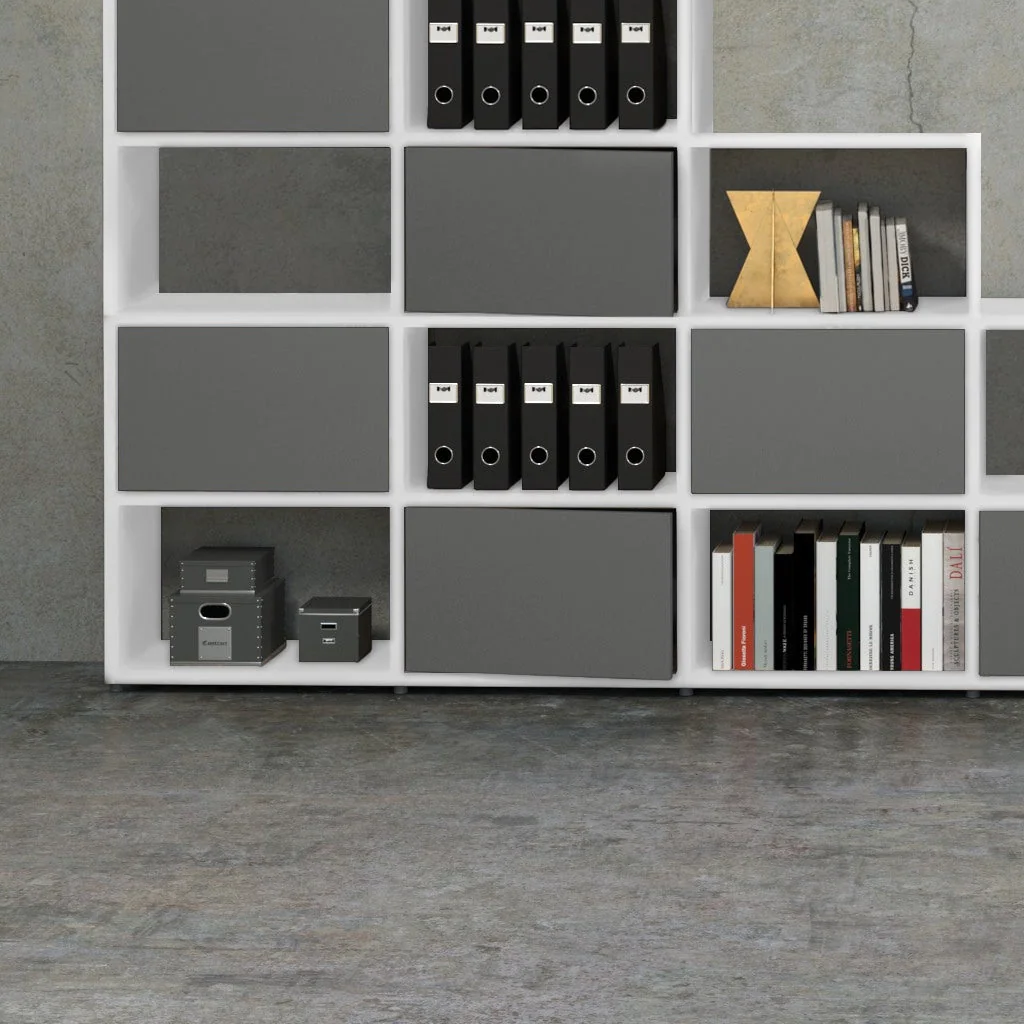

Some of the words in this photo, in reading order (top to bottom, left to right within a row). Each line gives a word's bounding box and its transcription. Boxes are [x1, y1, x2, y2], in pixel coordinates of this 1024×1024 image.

[900, 256, 911, 279] DICK
[947, 547, 963, 579] DALÍ
[953, 589, 961, 615] OBJECTS
[953, 624, 961, 665] SCULPTURES
